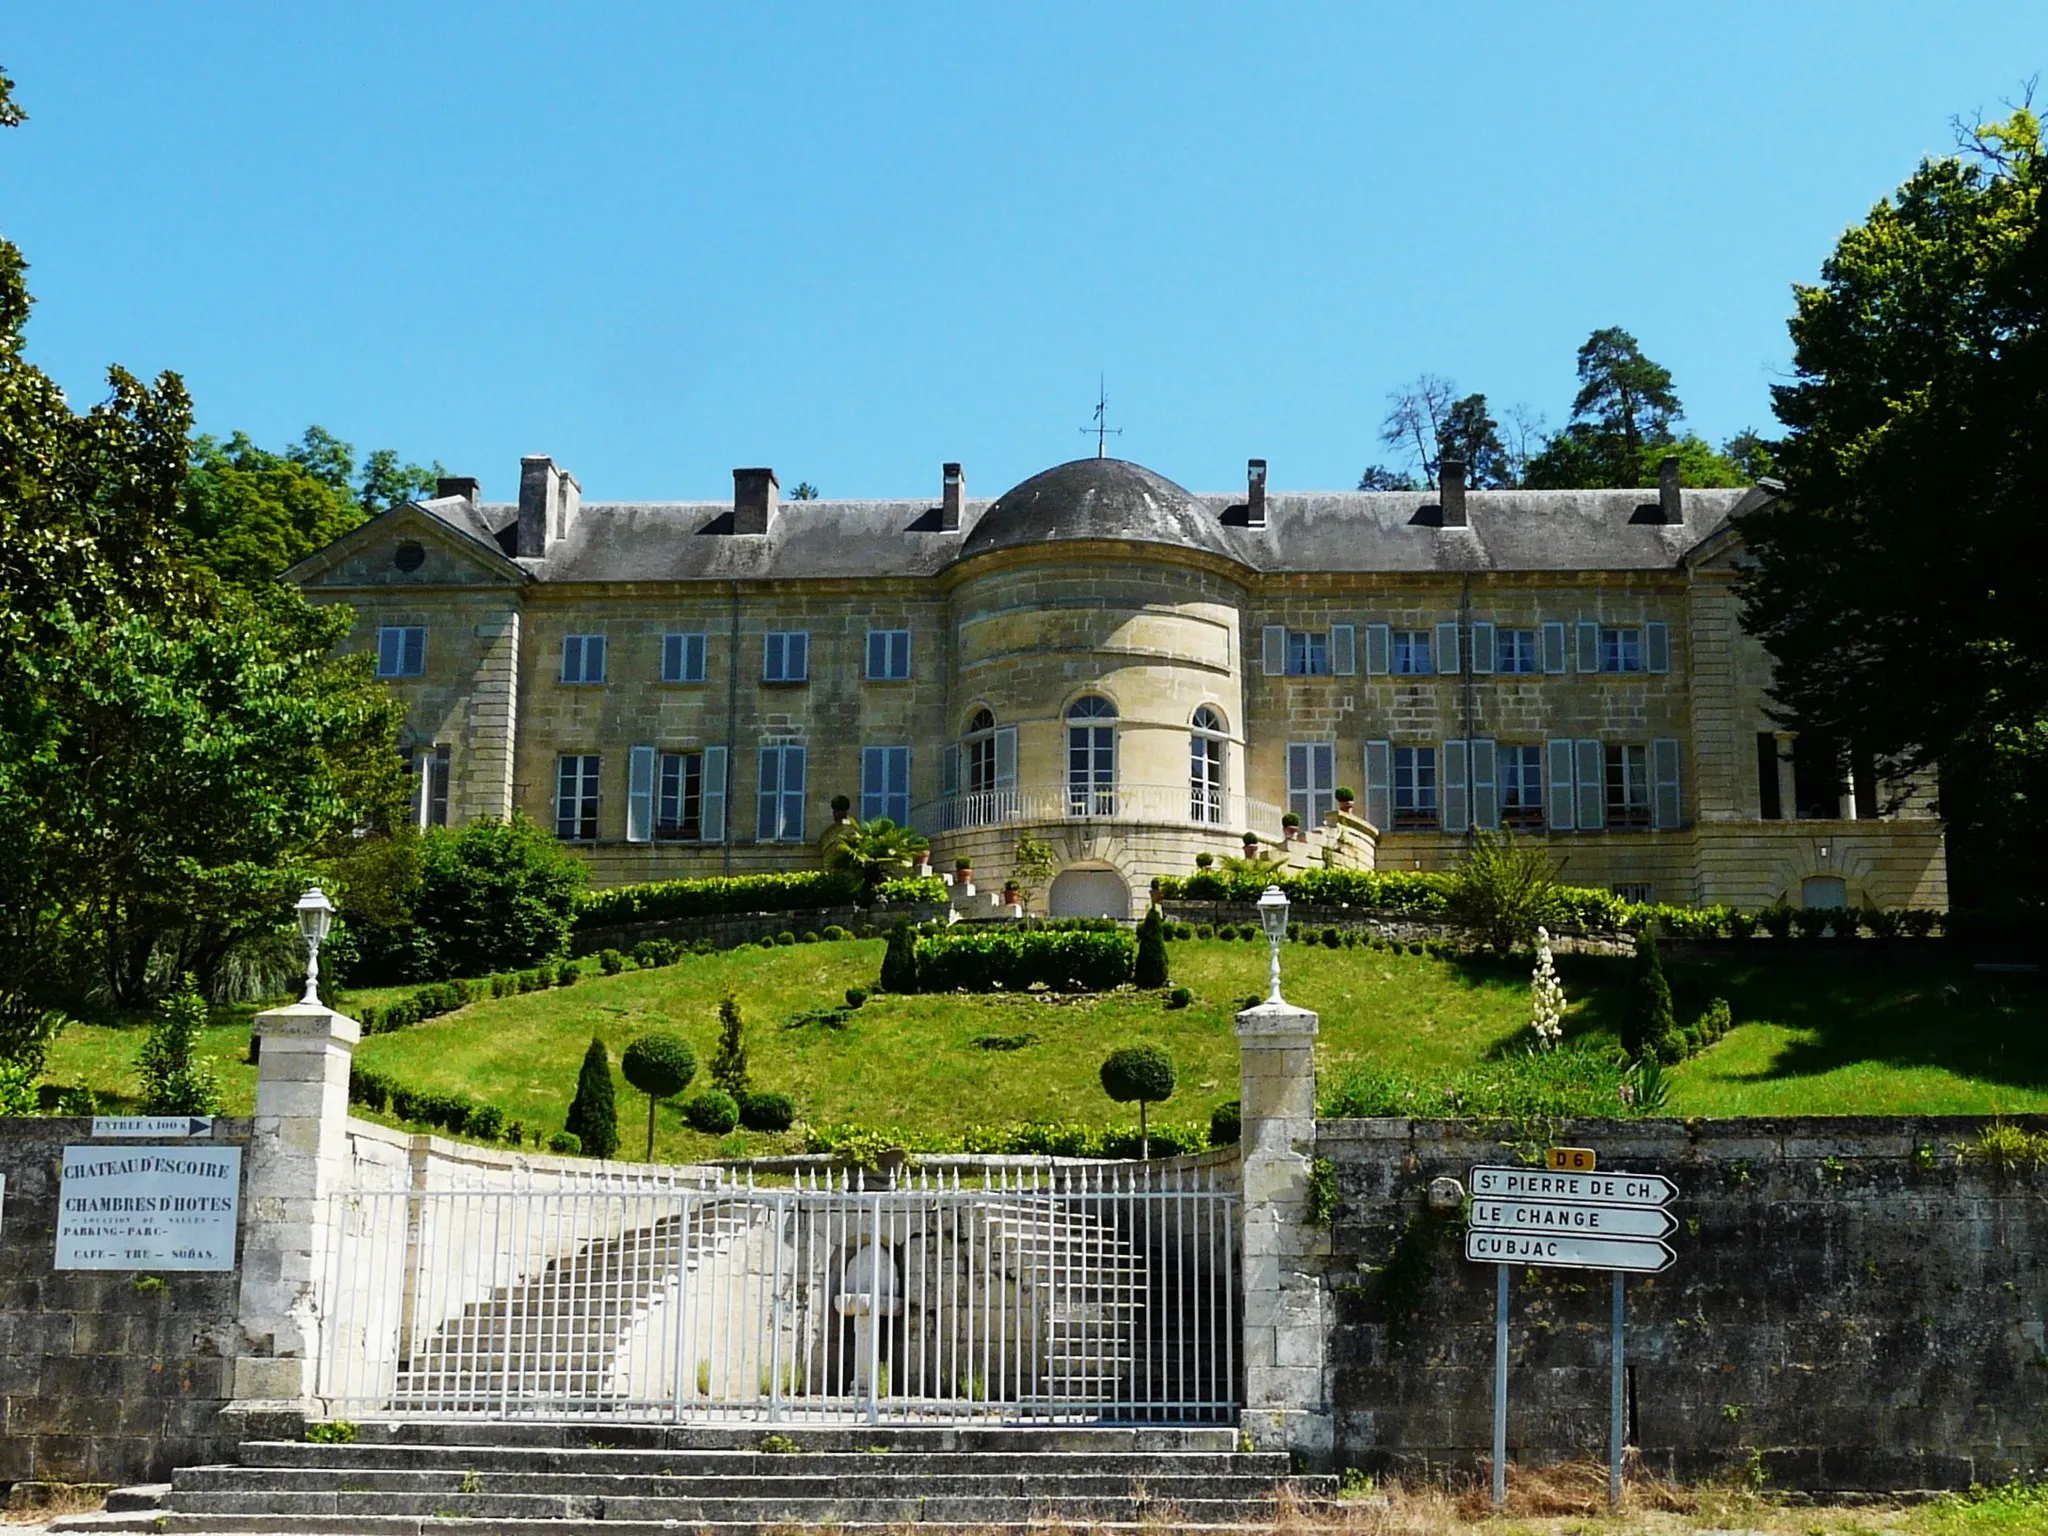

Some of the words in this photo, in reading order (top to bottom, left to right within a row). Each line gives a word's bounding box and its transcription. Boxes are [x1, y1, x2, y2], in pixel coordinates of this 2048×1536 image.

[64, 1158, 138, 1180] CHATEAU
[1556, 1152, 1567, 1166] D
[1573, 1153, 1584, 1167] 6
[1507, 1176, 1579, 1194] PIERRE
[1590, 1180, 1615, 1196] DE
[66, 1197, 156, 1212] CHAMBRES
[1479, 1206, 1502, 1222] LE
[1516, 1208, 1600, 1227] CHANGE
[1477, 1238, 1557, 1257] CUBJAC
